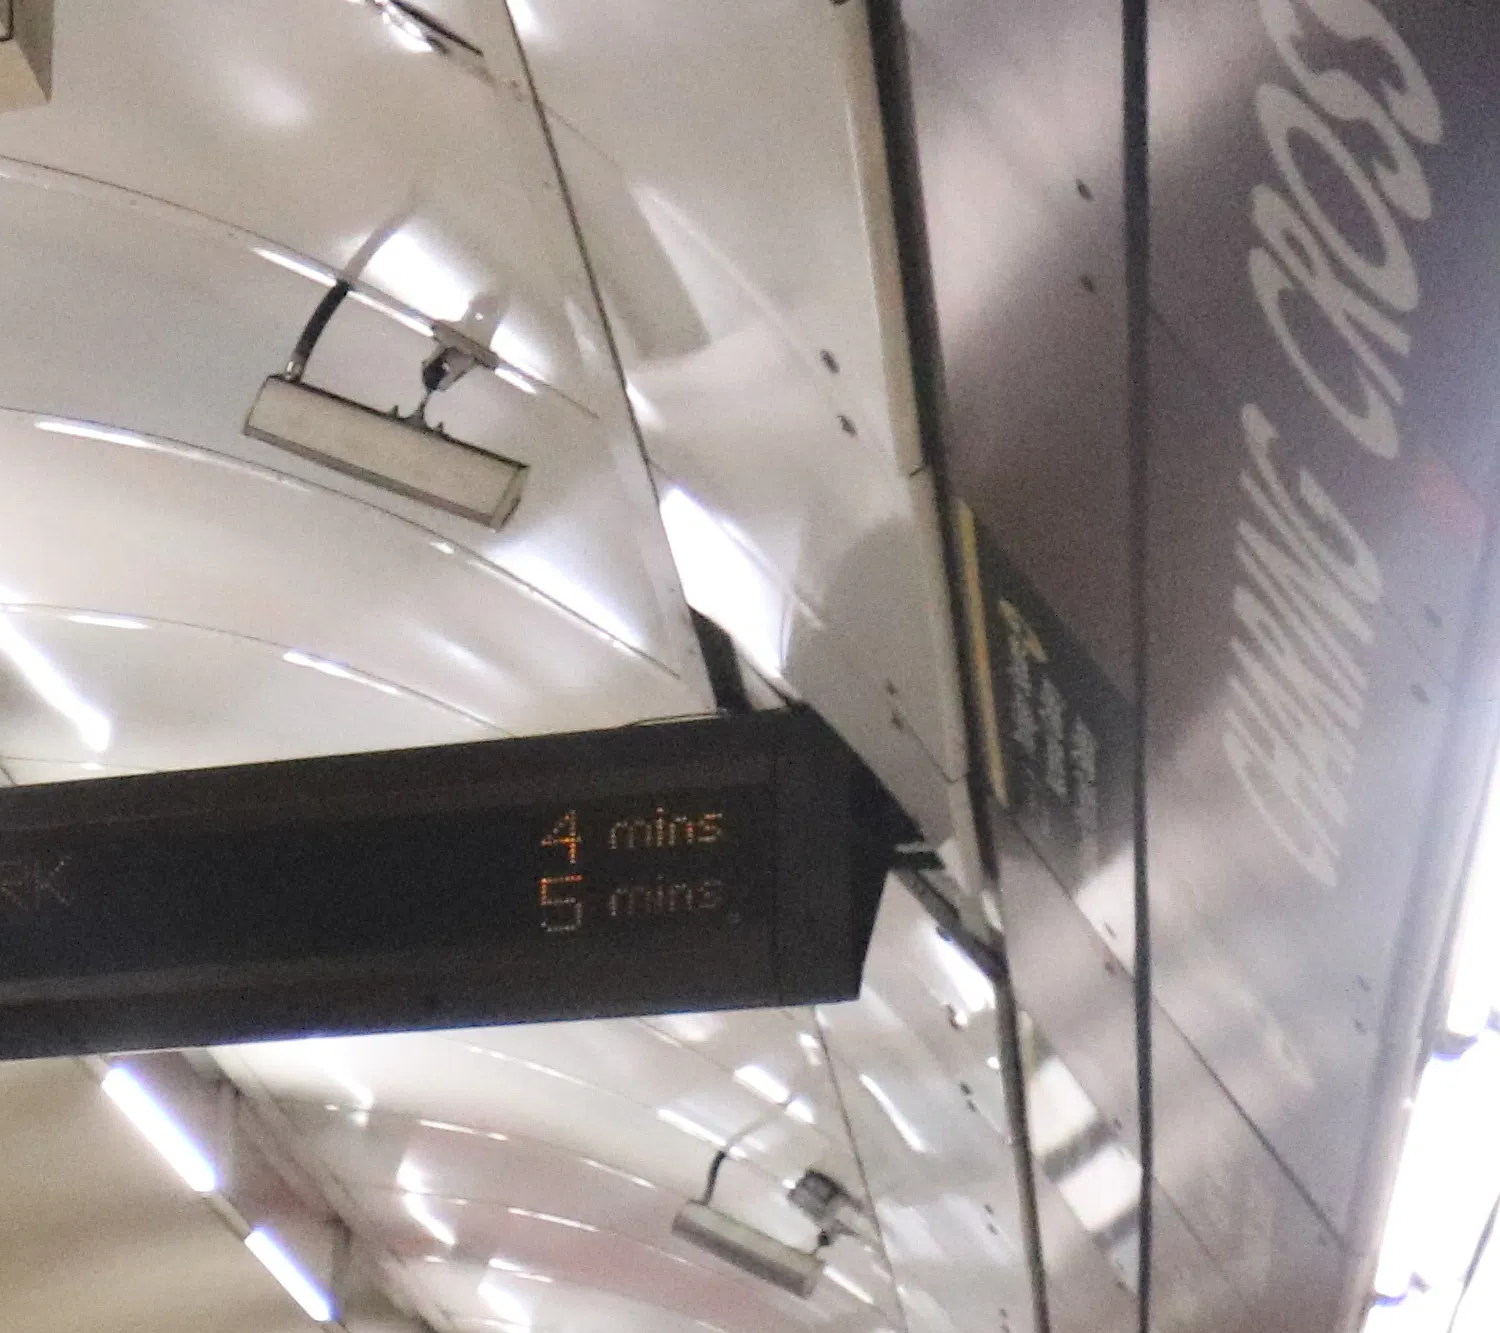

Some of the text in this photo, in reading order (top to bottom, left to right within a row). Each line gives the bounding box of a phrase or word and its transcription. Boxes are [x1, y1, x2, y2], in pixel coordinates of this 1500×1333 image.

[541, 808, 582, 865] 4
[609, 806, 724, 850] mins
[540, 874, 584, 933] 5
[609, 873, 723, 918] mins
